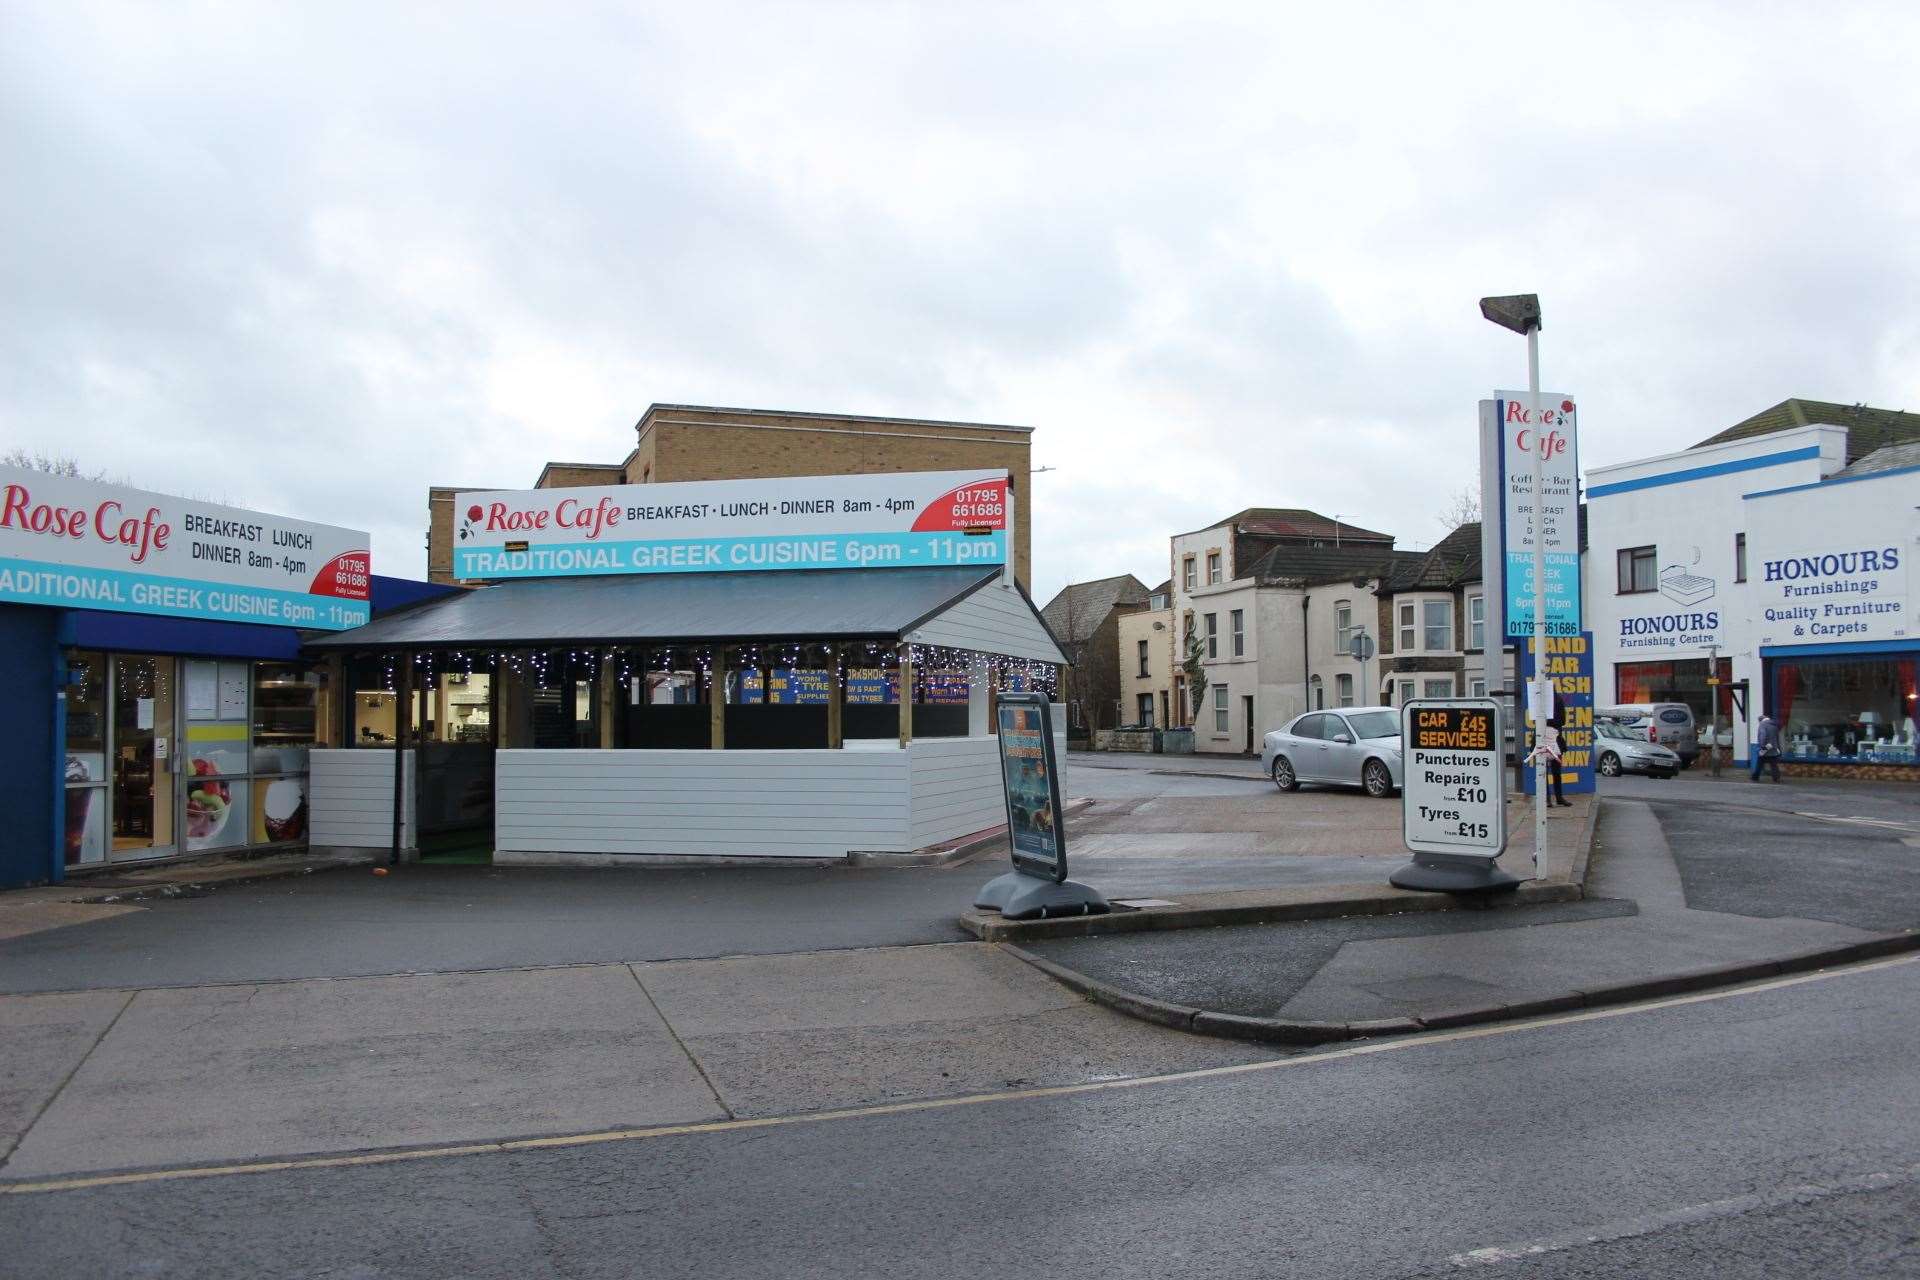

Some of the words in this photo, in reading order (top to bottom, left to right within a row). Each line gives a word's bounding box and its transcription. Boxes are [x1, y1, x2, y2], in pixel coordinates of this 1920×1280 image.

[1553, 476, 1571, 485] Bar
[956, 489, 998, 503] 01795
[1512, 485, 1570, 496] Resurant
[627, 505, 709, 520] BREAKFAST
[721, 502, 768, 517] LUNCH
[781, 500, 834, 515] DINNER
[843, 499, 871, 513] 8am
[885, 498, 915, 514] 4pm
[952, 503, 1002, 517] 661686
[1518, 506, 1564, 514] BREFAST
[1, 484, 87, 538] Rose
[94, 501, 171, 564] Cafe
[485, 502, 550, 532] Rose
[556, 496, 622, 540] Cafe
[185, 514, 263, 542] BREAKFAST
[273, 528, 313, 550] LUNCH
[1527, 527, 1556, 535] DER
[192, 542, 241, 565] DINNER
[248, 550, 272, 569] 8am
[282, 551, 306, 574] 4pm
[463, 547, 624, 572] TRADITIONAL
[632, 544, 722, 566] GREEK
[730, 540, 837, 564] CUISINE
[845, 540, 901, 566] 6pm
[928, 538, 996, 563] 11pm
[1509, 554, 1577, 565] TRADIONAL
[339, 558, 365, 573] 01795
[1764, 548, 1899, 582] HONOURS
[336, 572, 367, 587] 661686
[1525, 568, 1561, 579] GEEK
[1523, 583, 1564, 593] CUSINE
[1784, 579, 1878, 598] Furnishings
[132, 583, 203, 609] GREEK
[209, 590, 279, 616] CUISINE
[282, 603, 315, 625] 6pm
[329, 606, 366, 626] 11pm
[1547, 597, 1571, 611] 11pm
[1765, 607, 1817, 622] Quality
[1823, 602, 1901, 617] Furniture
[1511, 621, 1534, 634] 0179
[1620, 612, 1719, 636] HONOURS
[1793, 625, 1804, 636] &
[1810, 622, 1868, 637] Carpets
[1620, 636, 1675, 648] Furnishing
[1679, 633, 1714, 643] Centre
[744, 678, 787, 689] SERVING
[802, 682, 829, 690] TYRE
[1526, 676, 1591, 693] ASH
[1419, 712, 1448, 727] CAR
[1460, 716, 1487, 732] £45
[1525, 707, 1592, 727] OEN
[1419, 731, 1487, 748] SERVICES
[1525, 731, 1592, 747] ENCE
[1415, 752, 1490, 767] Punctures
[1425, 771, 1480, 787] Repairs
[1457, 787, 1487, 804] £10
[1419, 806, 1460, 822] Tyres
[1458, 822, 1489, 839] £15
